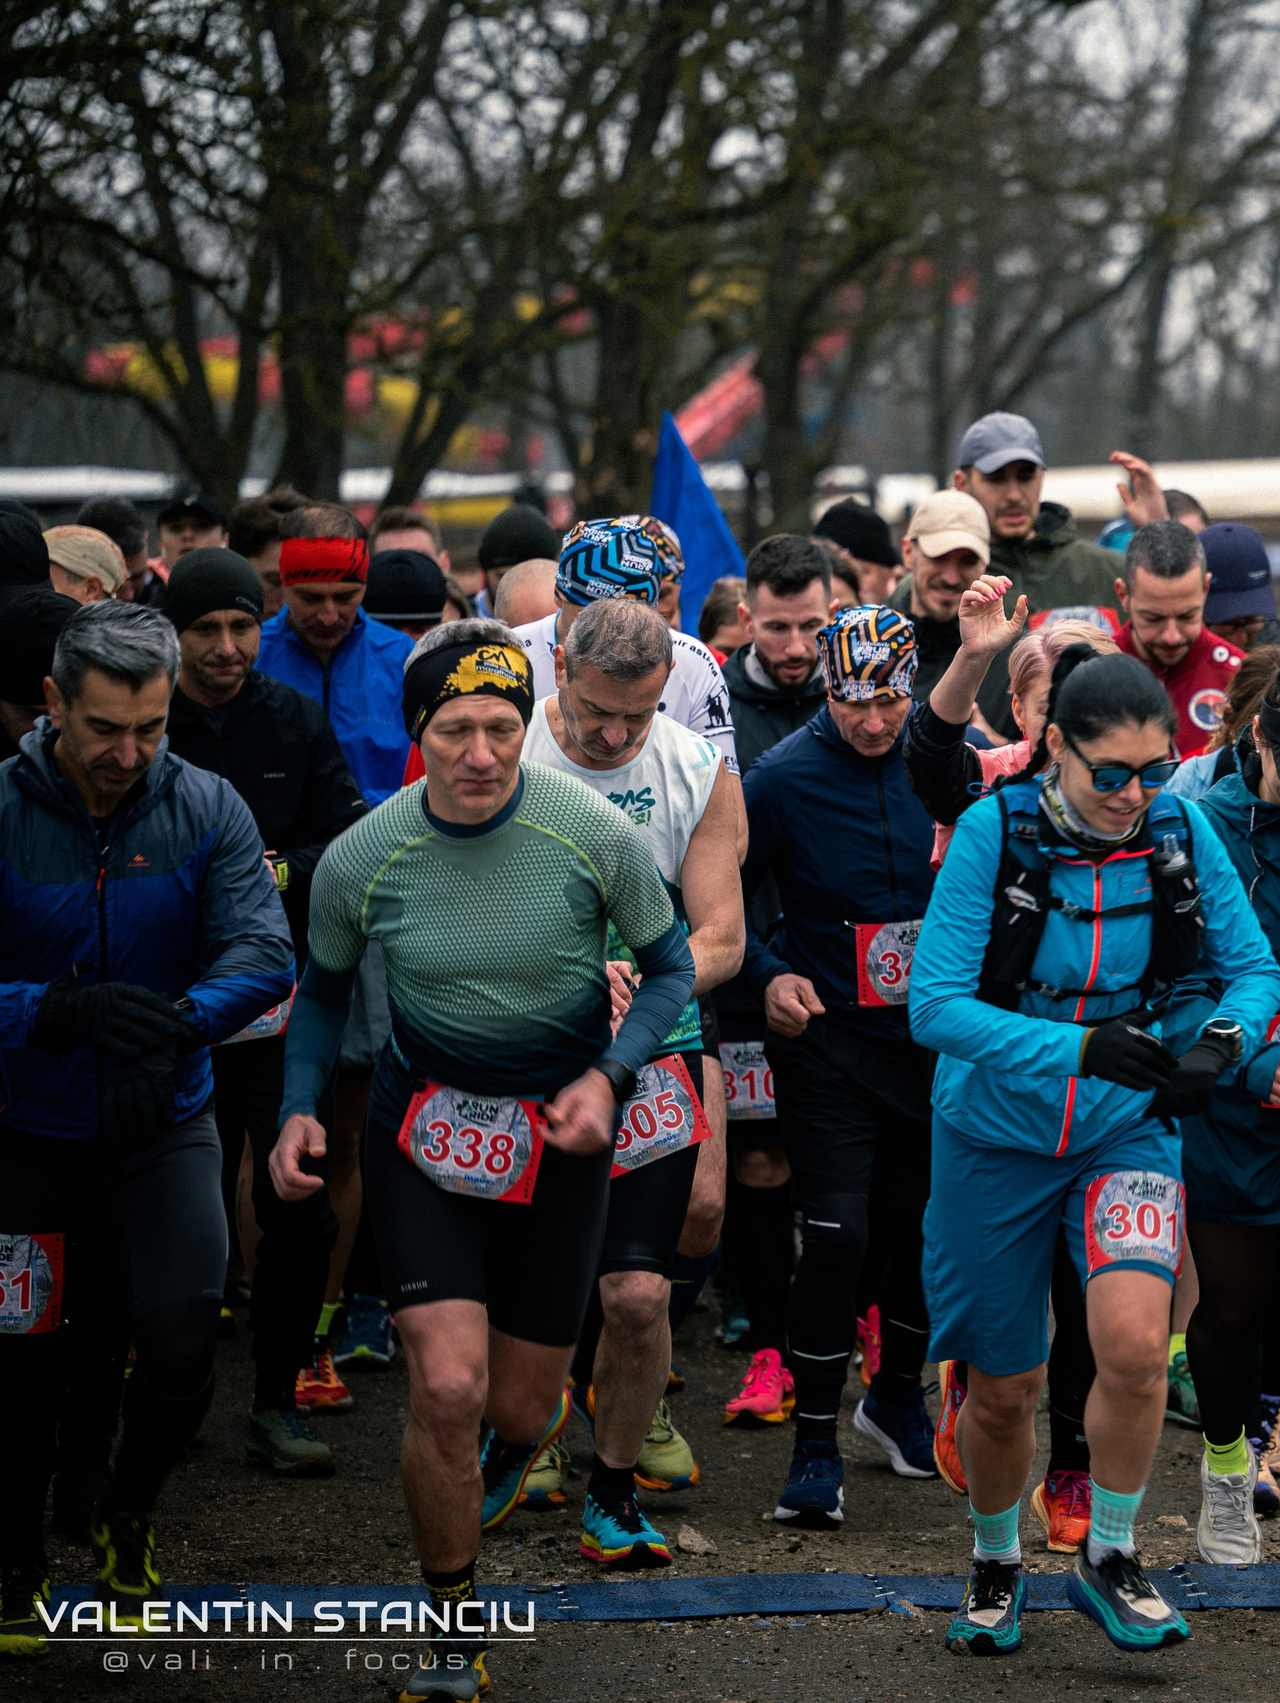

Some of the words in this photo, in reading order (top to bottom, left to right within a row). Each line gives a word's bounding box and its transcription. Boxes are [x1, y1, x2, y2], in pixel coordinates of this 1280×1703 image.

[475, 665, 516, 681] marathon
[471, 1101, 500, 1115] RUN
[469, 1110, 498, 1123] RIDE
[421, 1120, 516, 1175] 338
[654, 1134, 678, 1147] maus
[1105, 1202, 1178, 1250] 301
